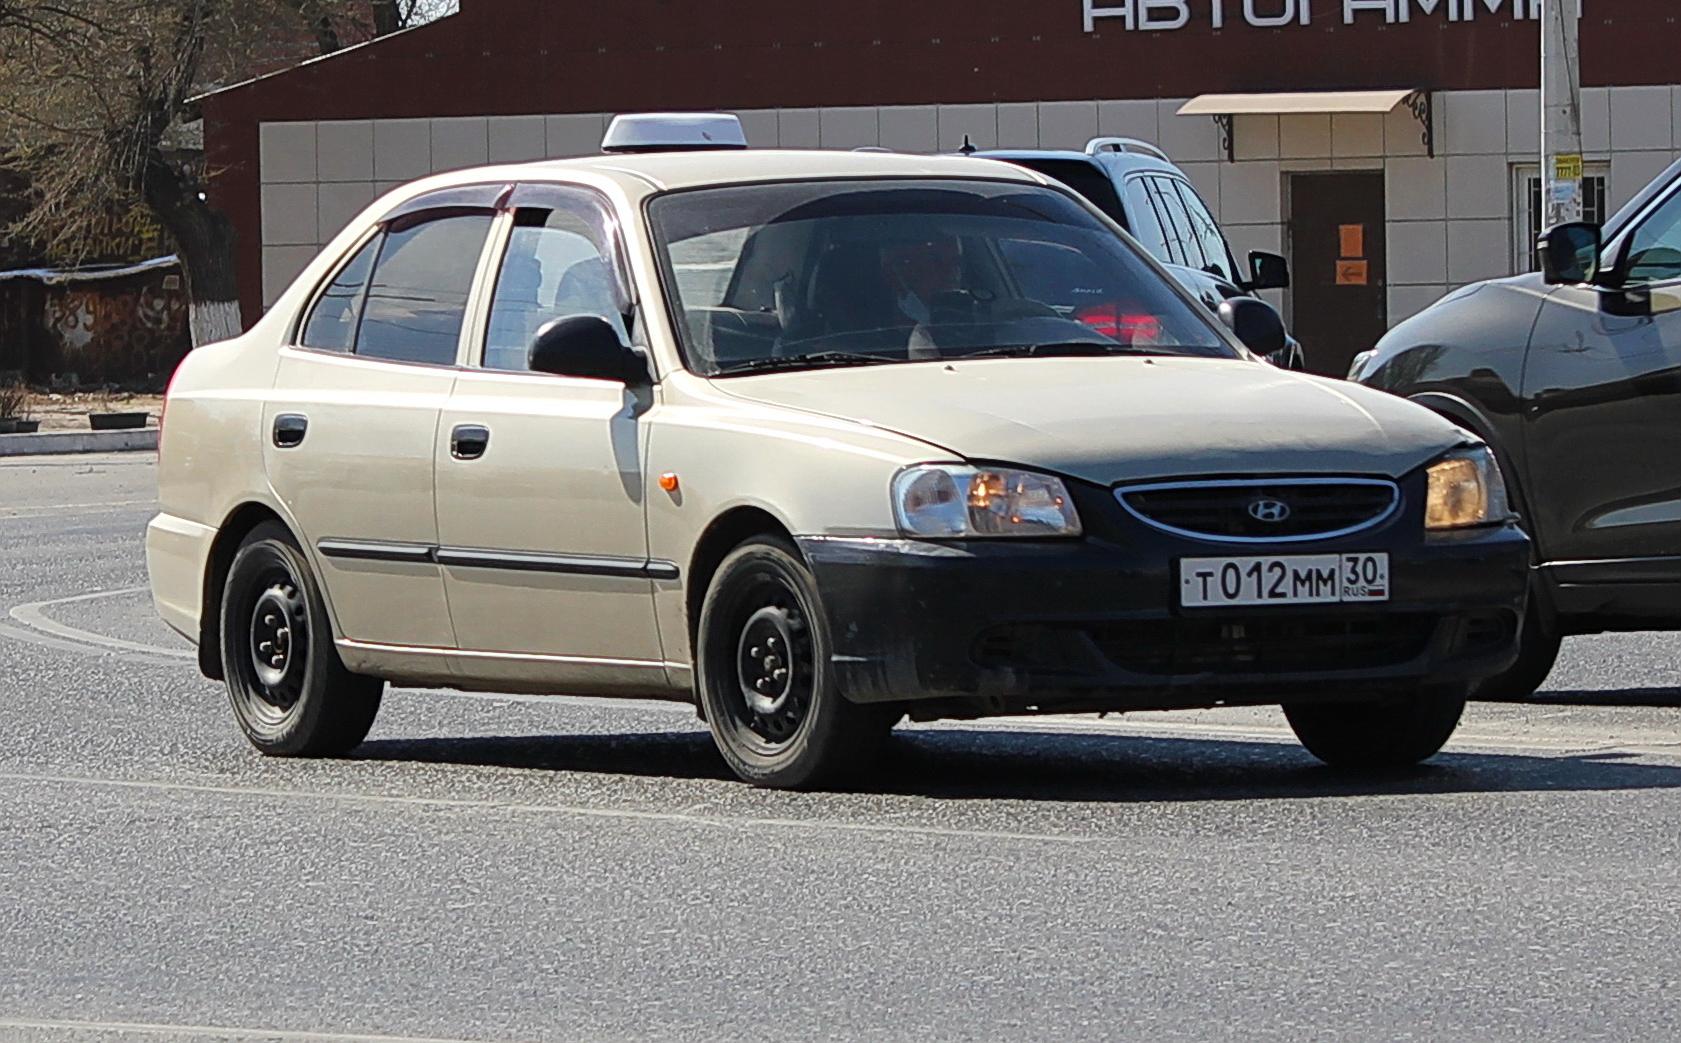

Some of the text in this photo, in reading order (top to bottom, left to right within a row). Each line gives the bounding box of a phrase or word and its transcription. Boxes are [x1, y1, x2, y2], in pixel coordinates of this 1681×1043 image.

[1195, 556, 1378, 600] Т012ММ 30
[1343, 586, 1367, 597] RUS
